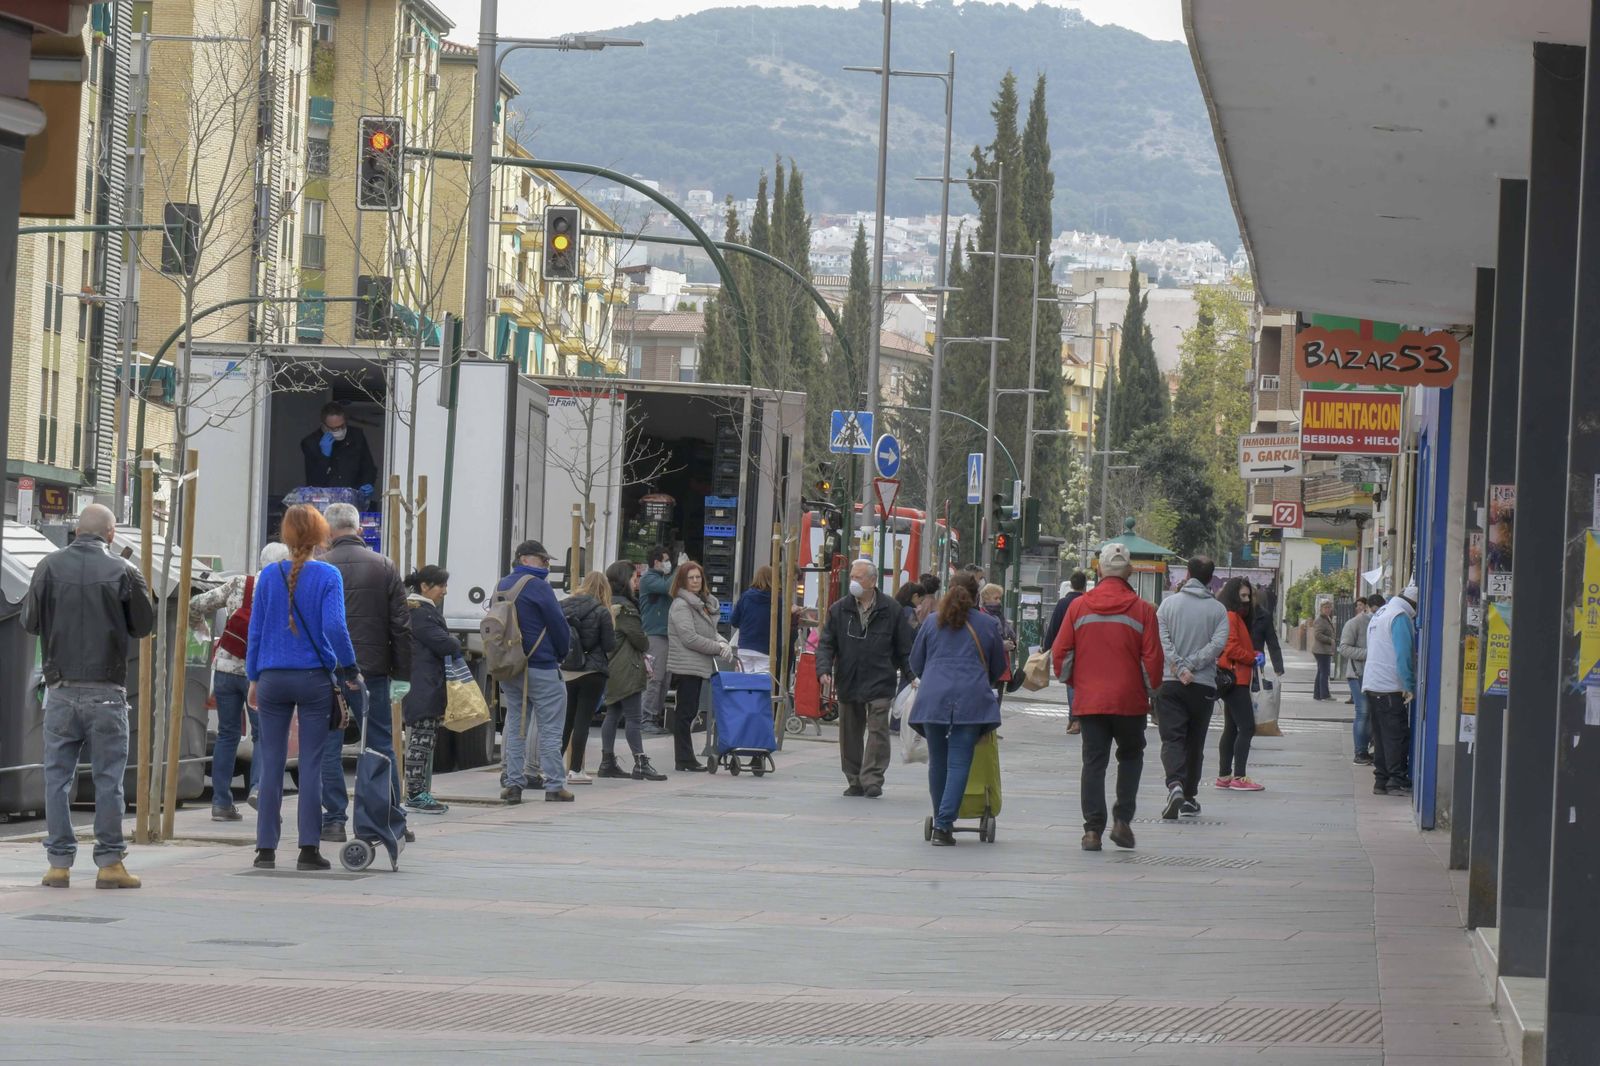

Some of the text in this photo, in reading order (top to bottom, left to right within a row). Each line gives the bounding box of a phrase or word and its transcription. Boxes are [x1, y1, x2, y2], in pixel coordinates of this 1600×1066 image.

[1303, 401, 1400, 430] ALIMENTACION
[1242, 436, 1299, 447] INMOBILIARIA
[1302, 434, 1354, 445] BEBIDAS
[1364, 436, 1400, 446] HIELO
[1242, 451, 1254, 463] D.
[1493, 583, 1507, 592] 21
